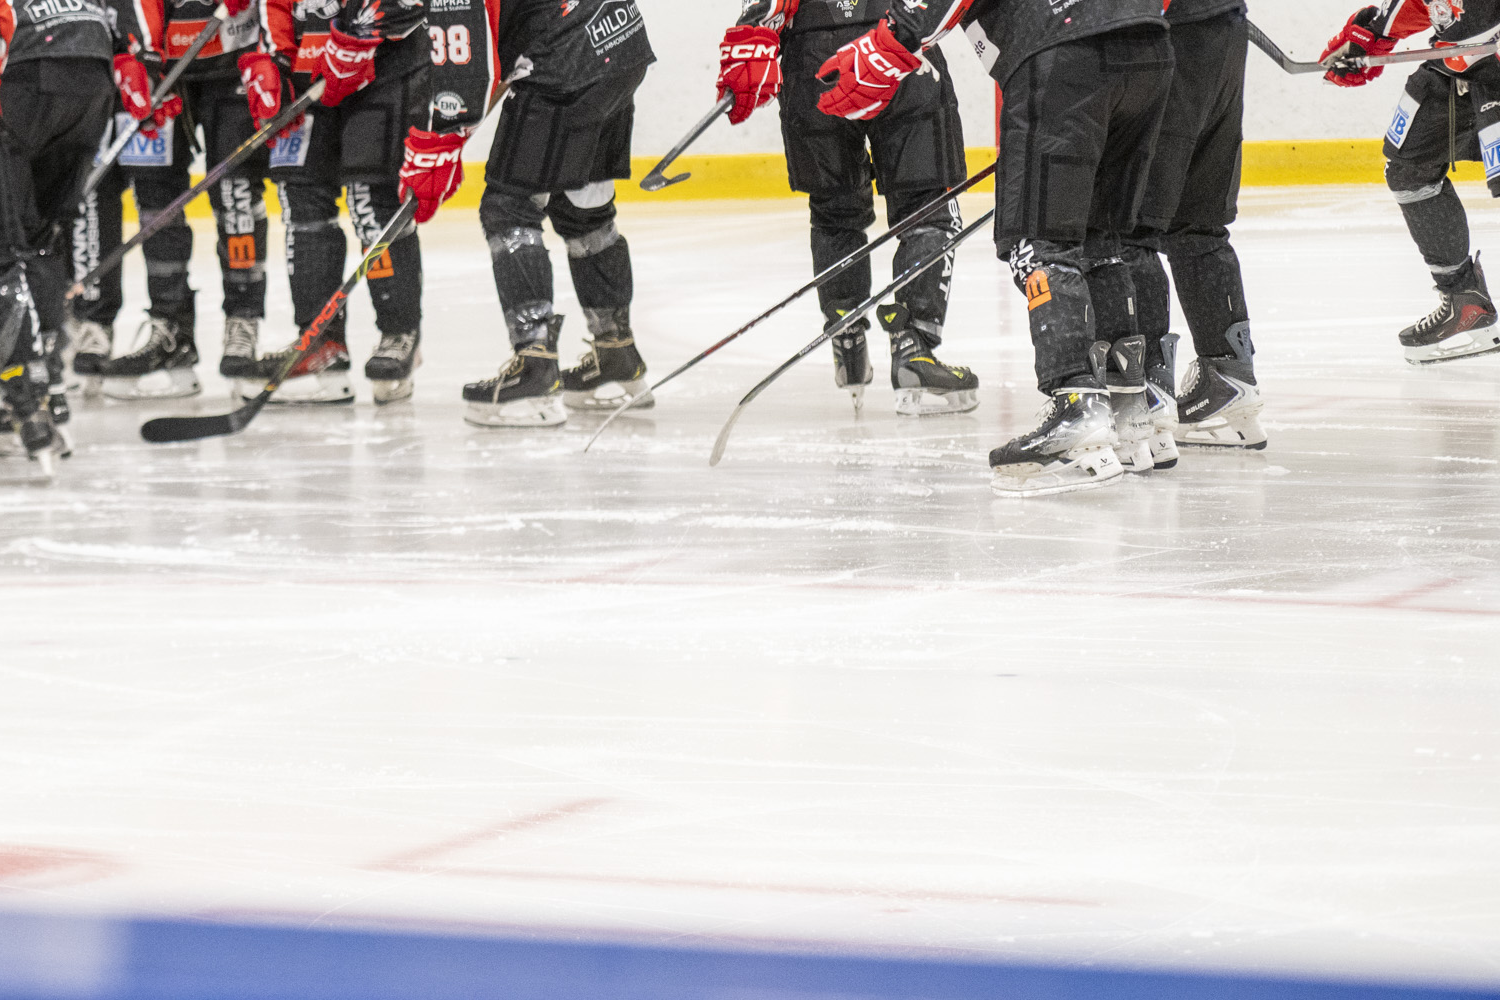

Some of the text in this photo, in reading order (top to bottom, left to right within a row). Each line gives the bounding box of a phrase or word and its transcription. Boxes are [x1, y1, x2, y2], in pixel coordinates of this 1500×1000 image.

[591, 7, 629, 43] HILD
[1352, 31, 1371, 42] CCM
[327, 37, 377, 64] CCM
[429, 24, 472, 67] 38
[720, 45, 775, 61] CCM
[858, 36, 911, 82] CCM
[440, 100, 459, 113] EHV
